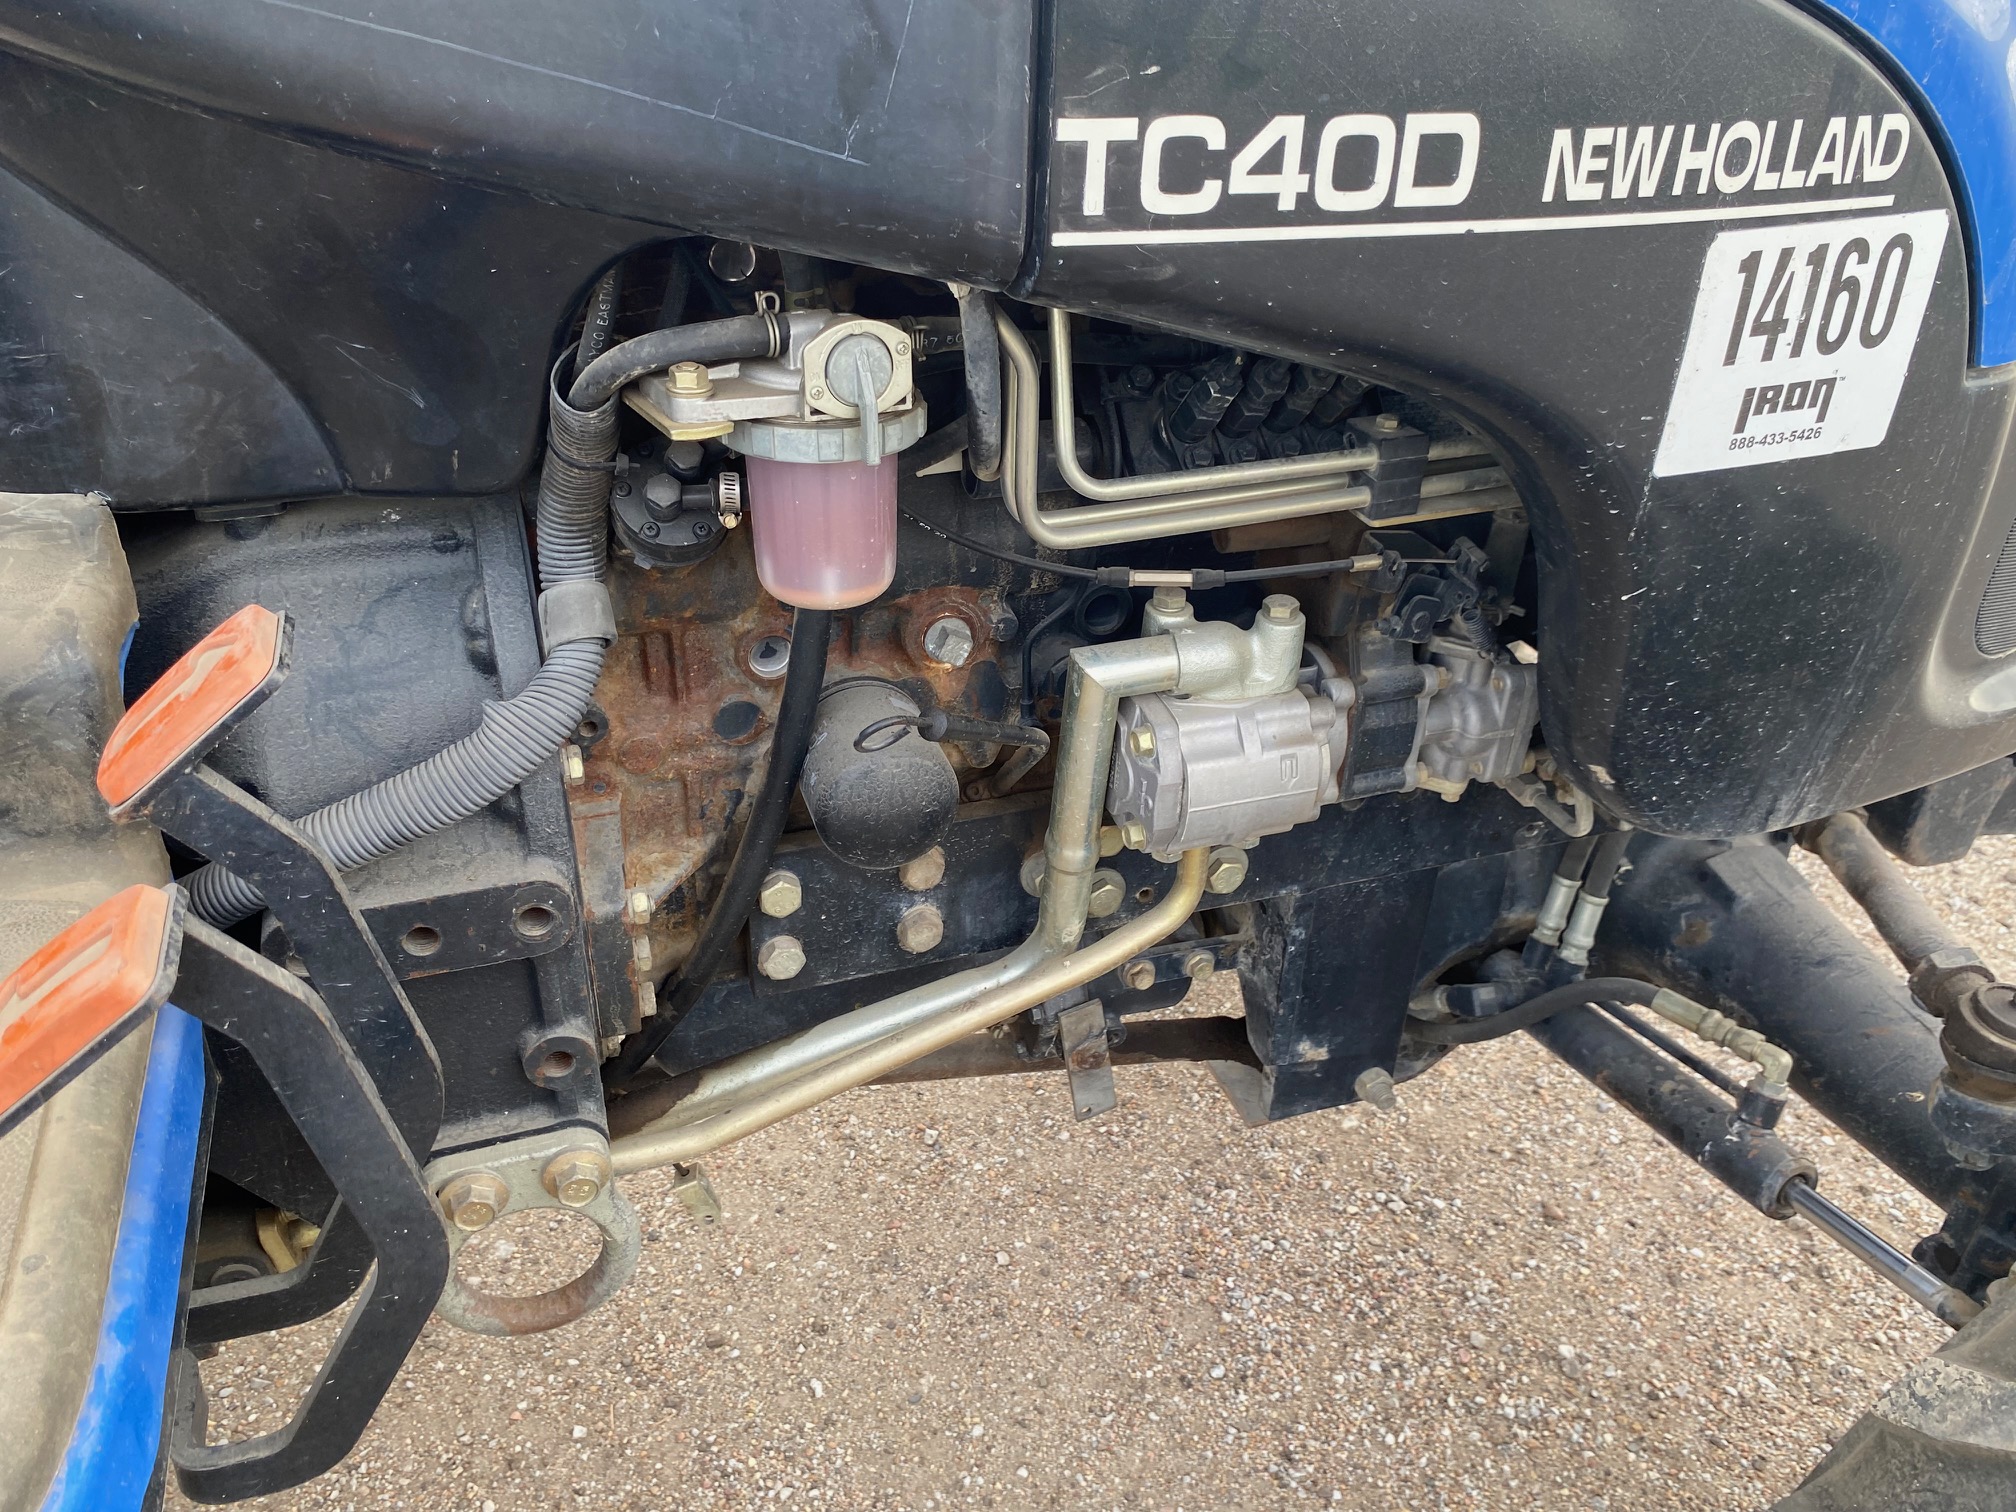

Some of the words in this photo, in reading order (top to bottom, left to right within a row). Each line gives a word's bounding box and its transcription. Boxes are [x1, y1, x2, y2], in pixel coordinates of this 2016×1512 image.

[1055, 112, 1482, 216] TC40D
[1541, 123, 1675, 203] NEW
[1672, 112, 1911, 197] HOLLAND
[1722, 232, 1914, 368] 14160
[1728, 426, 1823, 451] 888-433-5426
